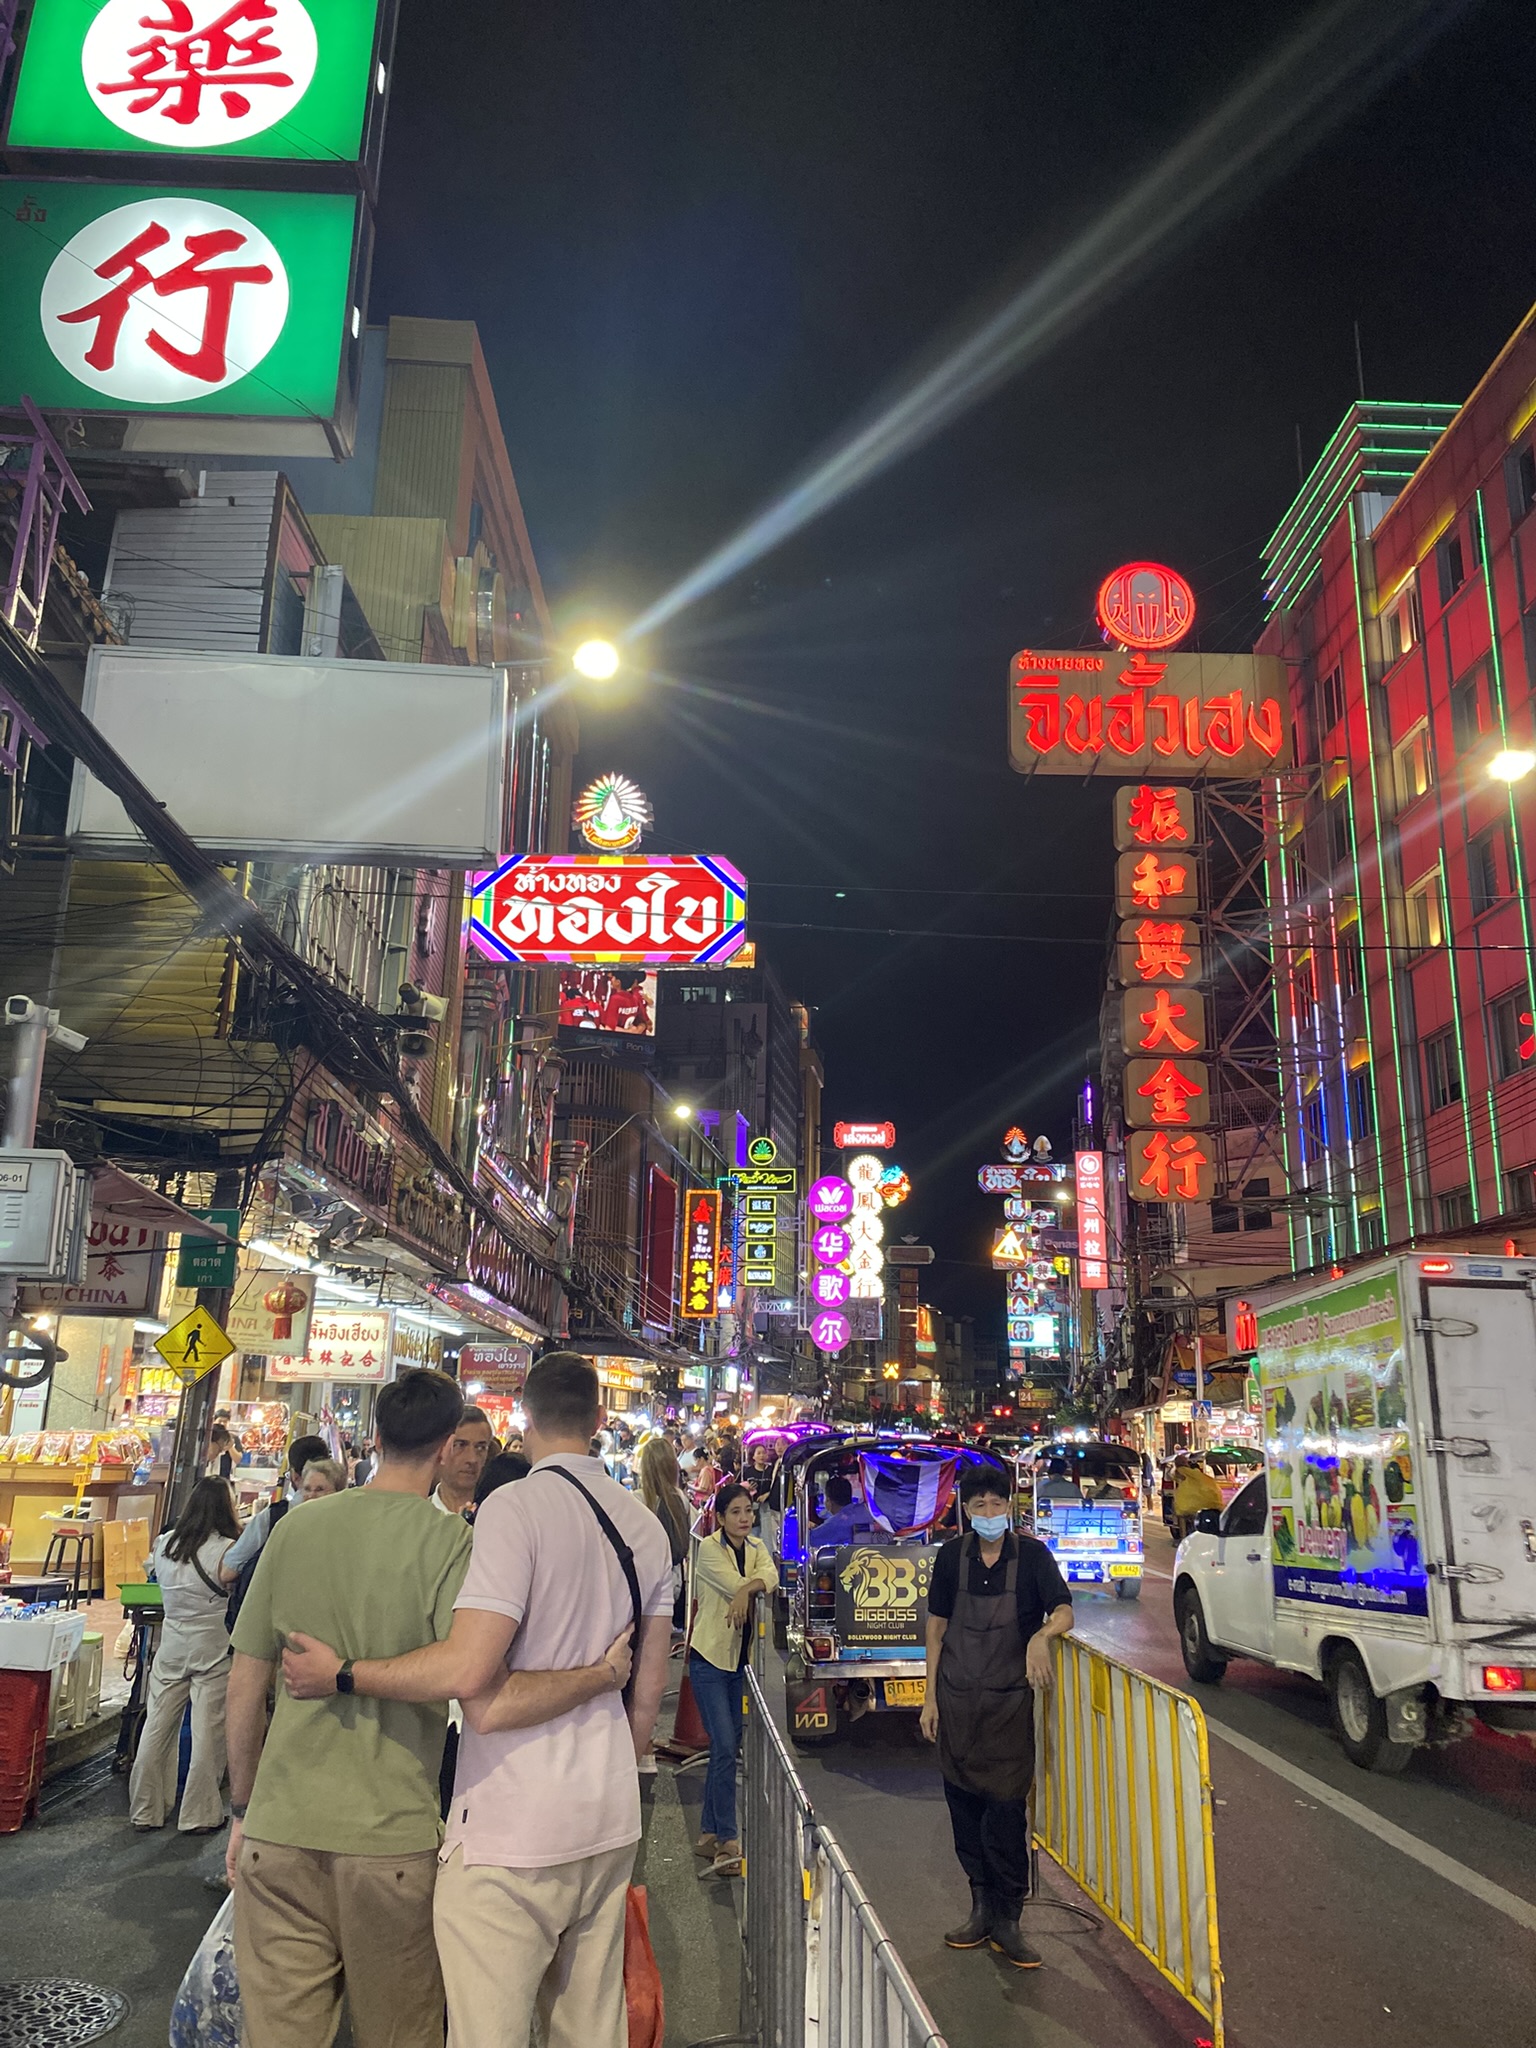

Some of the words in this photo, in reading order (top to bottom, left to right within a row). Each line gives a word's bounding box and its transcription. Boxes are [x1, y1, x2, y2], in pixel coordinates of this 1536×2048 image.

[1018, 648, 1104, 671] ห้างขายทอง
[1016, 653, 1283, 757] จินฮั้วเฮง
[514, 866, 621, 893] ห้างทอง
[497, 872, 718, 945] ทองใบ
[1128, 784, 1207, 1198] 振和興大金行
[815, 1205, 847, 1213] Wacoal
[856, 1164, 876, 1297] 龍鳳大金行
[1083, 1197, 1102, 1278] 兰州拉面
[192, 1258, 221, 1268] ตลาด
[197, 1273, 213, 1284] เก่า
[818, 1232, 843, 1344] 华歌尔
[64, 1287, 128, 1305] CHINA
[473, 1347, 518, 1362] ทองใบ
[1298, 1520, 1347, 1570] Delivery
[854, 1609, 918, 1622] BIGBOSS
[867, 1622, 887, 1630] NIGHT
[795, 1713, 829, 1729] WD
